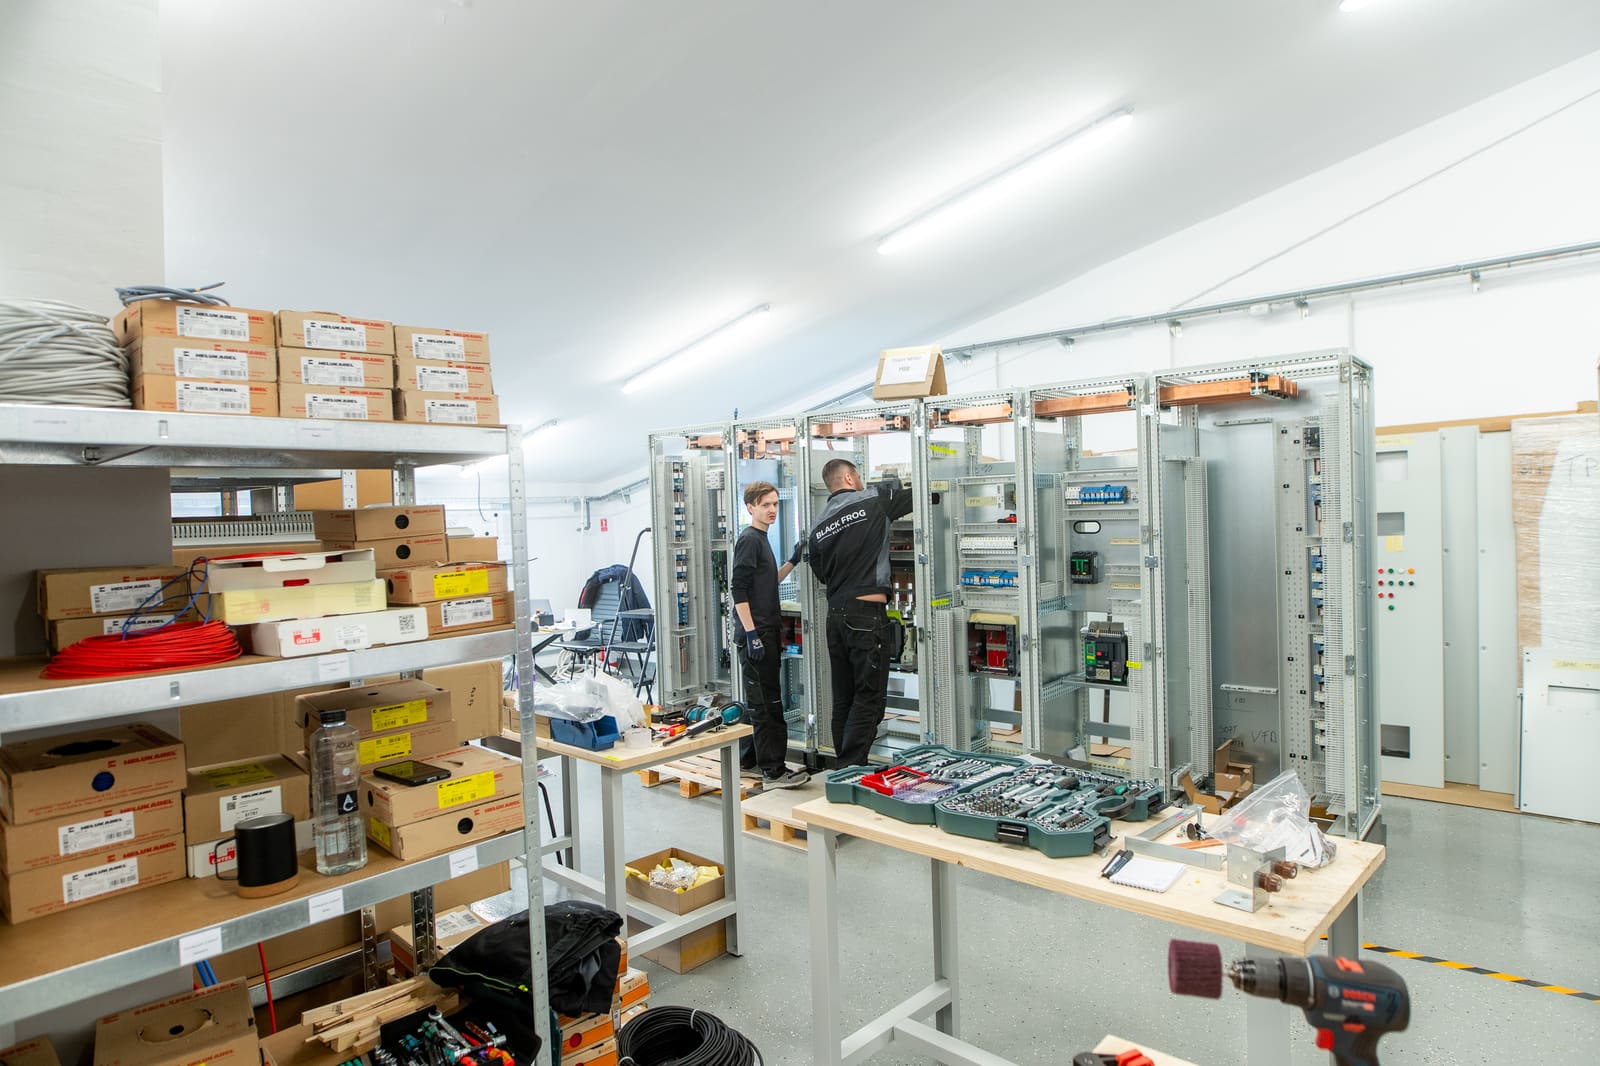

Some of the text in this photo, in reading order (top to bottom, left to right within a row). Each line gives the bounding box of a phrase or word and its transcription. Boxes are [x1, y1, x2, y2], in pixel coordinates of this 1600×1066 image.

[815, 509, 866, 539] BLACK FROG
[123, 750, 177, 766] HELUKABEL
[123, 841, 177, 859] HELUKABEL
